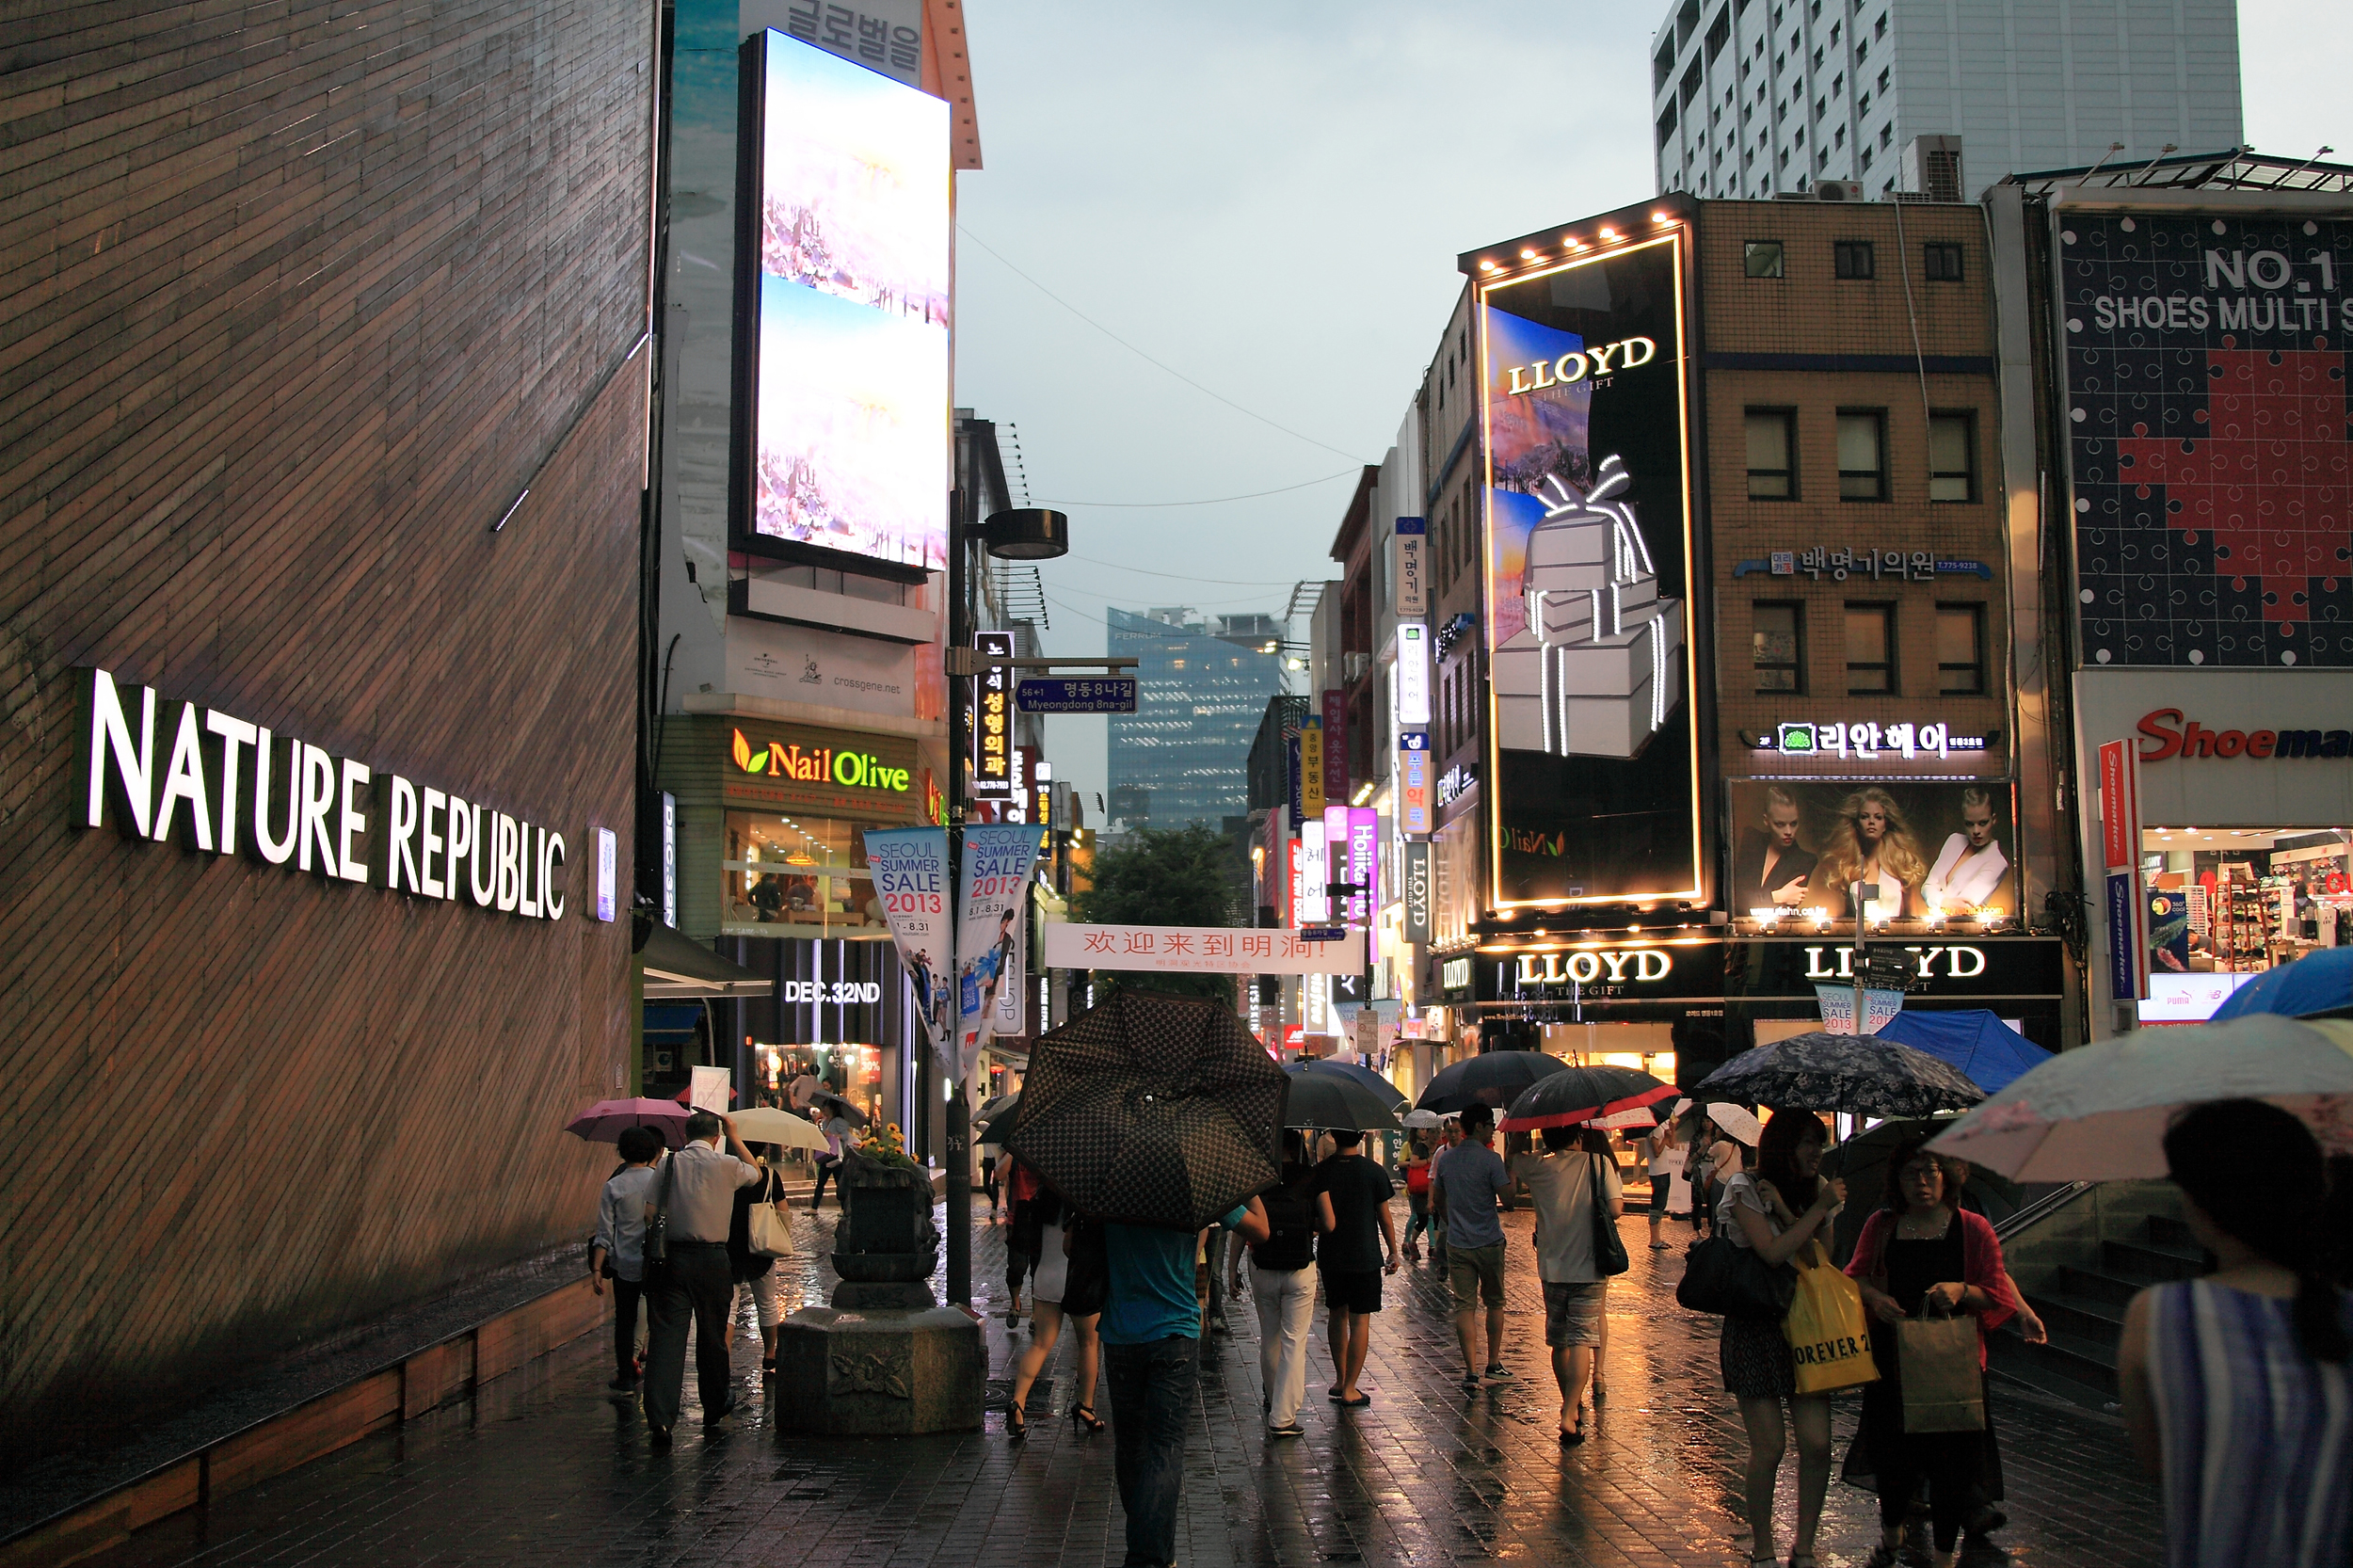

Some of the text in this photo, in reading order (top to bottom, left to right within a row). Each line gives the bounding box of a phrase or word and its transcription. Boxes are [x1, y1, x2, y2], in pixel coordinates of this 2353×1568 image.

[789, 0, 920, 72] 글로벌을
[2205, 249, 2333, 292] NO.1
[2095, 296, 2209, 329] SHOES
[2218, 297, 2328, 330] MULTI
[1508, 336, 1657, 395] LLOYD
[1544, 376, 1614, 402] THE GIFT
[1404, 540, 1418, 594] 백명기
[1801, 546, 1934, 581] 백명기의원
[834, 676, 901, 695] crossgene.net
[1064, 682, 1133, 697] 명동8나길
[1028, 699, 1132, 711] Myeongdong 8na-gil
[984, 693, 1006, 776] 성형외과
[1818, 722, 1947, 759] 리안헤어
[2135, 708, 2353, 761] Shoema
[768, 743, 909, 792] Nail Olive
[88, 667, 371, 884] NATURE
[388, 773, 565, 920] REPUBLIC
[978, 829, 1031, 846] SEOUL
[879, 842, 938, 858] SEOUL
[976, 845, 1031, 858] SUMMER
[664, 806, 675, 928] DEC.32N
[881, 859, 939, 872] SUMMER
[973, 857, 1028, 877] SALE
[1306, 847, 1324, 898] 헤어
[882, 873, 940, 892] SALE
[971, 876, 1021, 898] 2013
[1413, 858, 1426, 926] LLOYD
[885, 893, 941, 914] 2013
[984, 904, 1004, 914] 8.31
[909, 923, 929, 932] 8.31
[1083, 930, 1325, 959] 欢迎来到明洞!
[1156, 959, 1251, 968] 明洞观光特区协会
[1518, 951, 1672, 983] LLOYD
[1805, 946, 1986, 977] LLYD
[1443, 958, 1469, 988] LLOYD
[785, 981, 881, 1003] DEC.32ND
[1309, 973, 1326, 1024] nisfree
[1556, 985, 1625, 996] THE GIFT
[1822, 993, 1850, 1001] SEOUL
[1870, 991, 1897, 1000] SEOUL
[1250, 1004, 1259, 1032] SKIN
[1823, 1009, 1851, 1018] SALE
[1869, 1006, 1897, 1016] SALE
[1824, 1018, 1851, 1029] 2013
[861, 1061, 880, 1071] 30%
